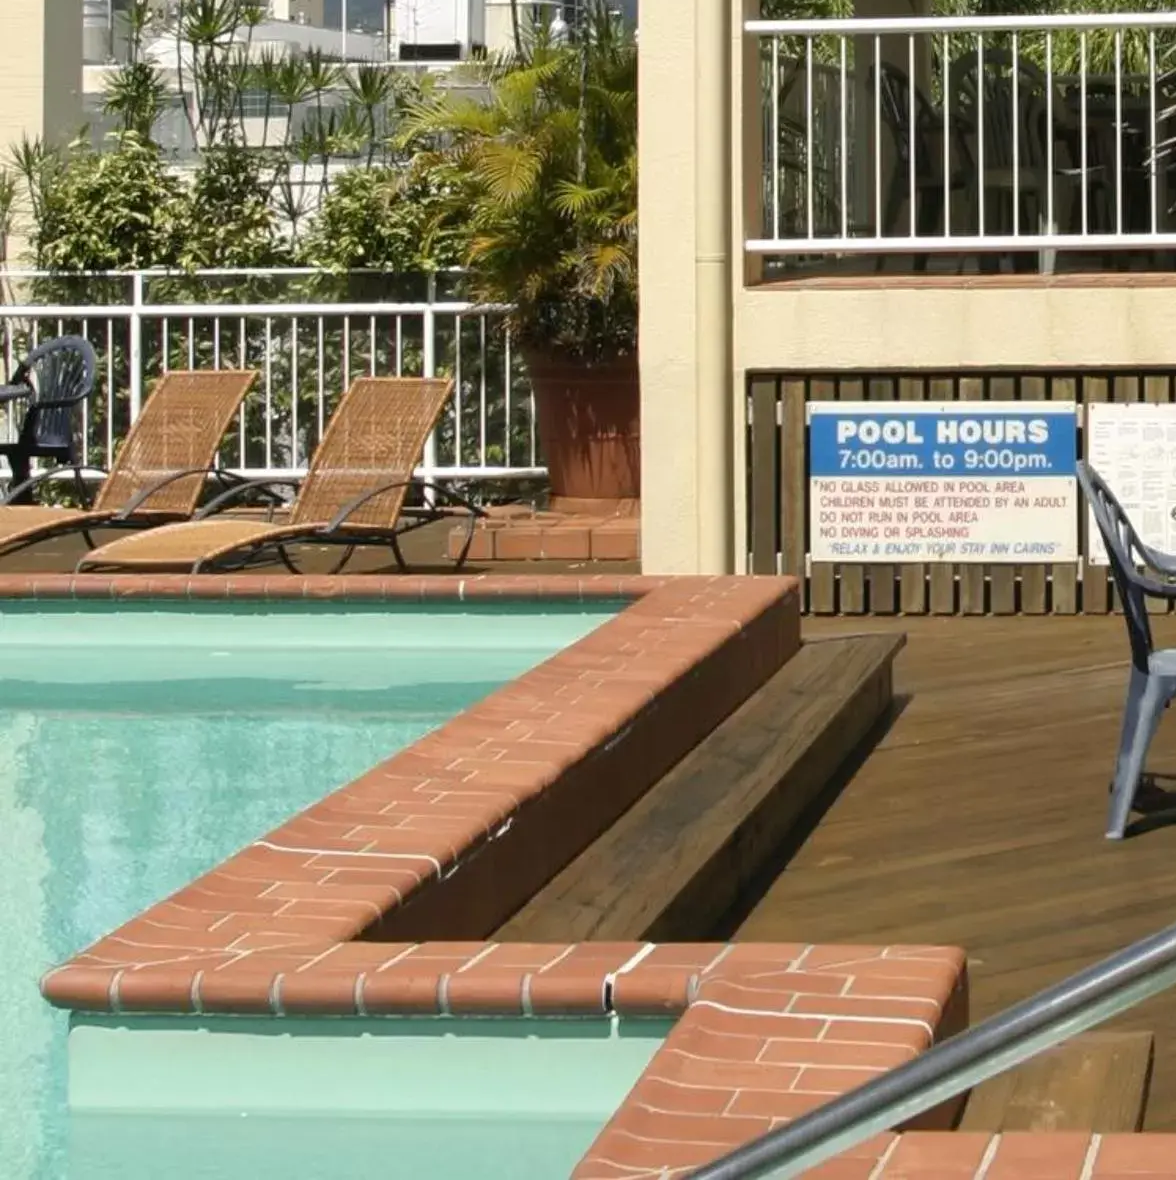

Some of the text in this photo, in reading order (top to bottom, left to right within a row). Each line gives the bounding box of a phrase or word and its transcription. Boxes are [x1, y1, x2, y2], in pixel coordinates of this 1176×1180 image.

[837, 420, 1049, 444] POOL HOURS
[839, 449, 1053, 472] 7:00am. to 9:00pm.
[819, 480, 1025, 493] NO GLASS ALLOWED IN POOL AREA
[820, 495, 1067, 508] CHILDREN MUST BE ATTENDED BY AN ADULT
[819, 511, 979, 523] DO NOT RUN IN POOL AREA
[819, 526, 970, 538] NO DIVING OR SPLASHING
[872, 541, 880, 555] &
[884, 541, 921, 555] ENJOY
[925, 541, 957, 555] YOUR
[960, 541, 986, 555] STAY
[990, 541, 1010, 555] INN
